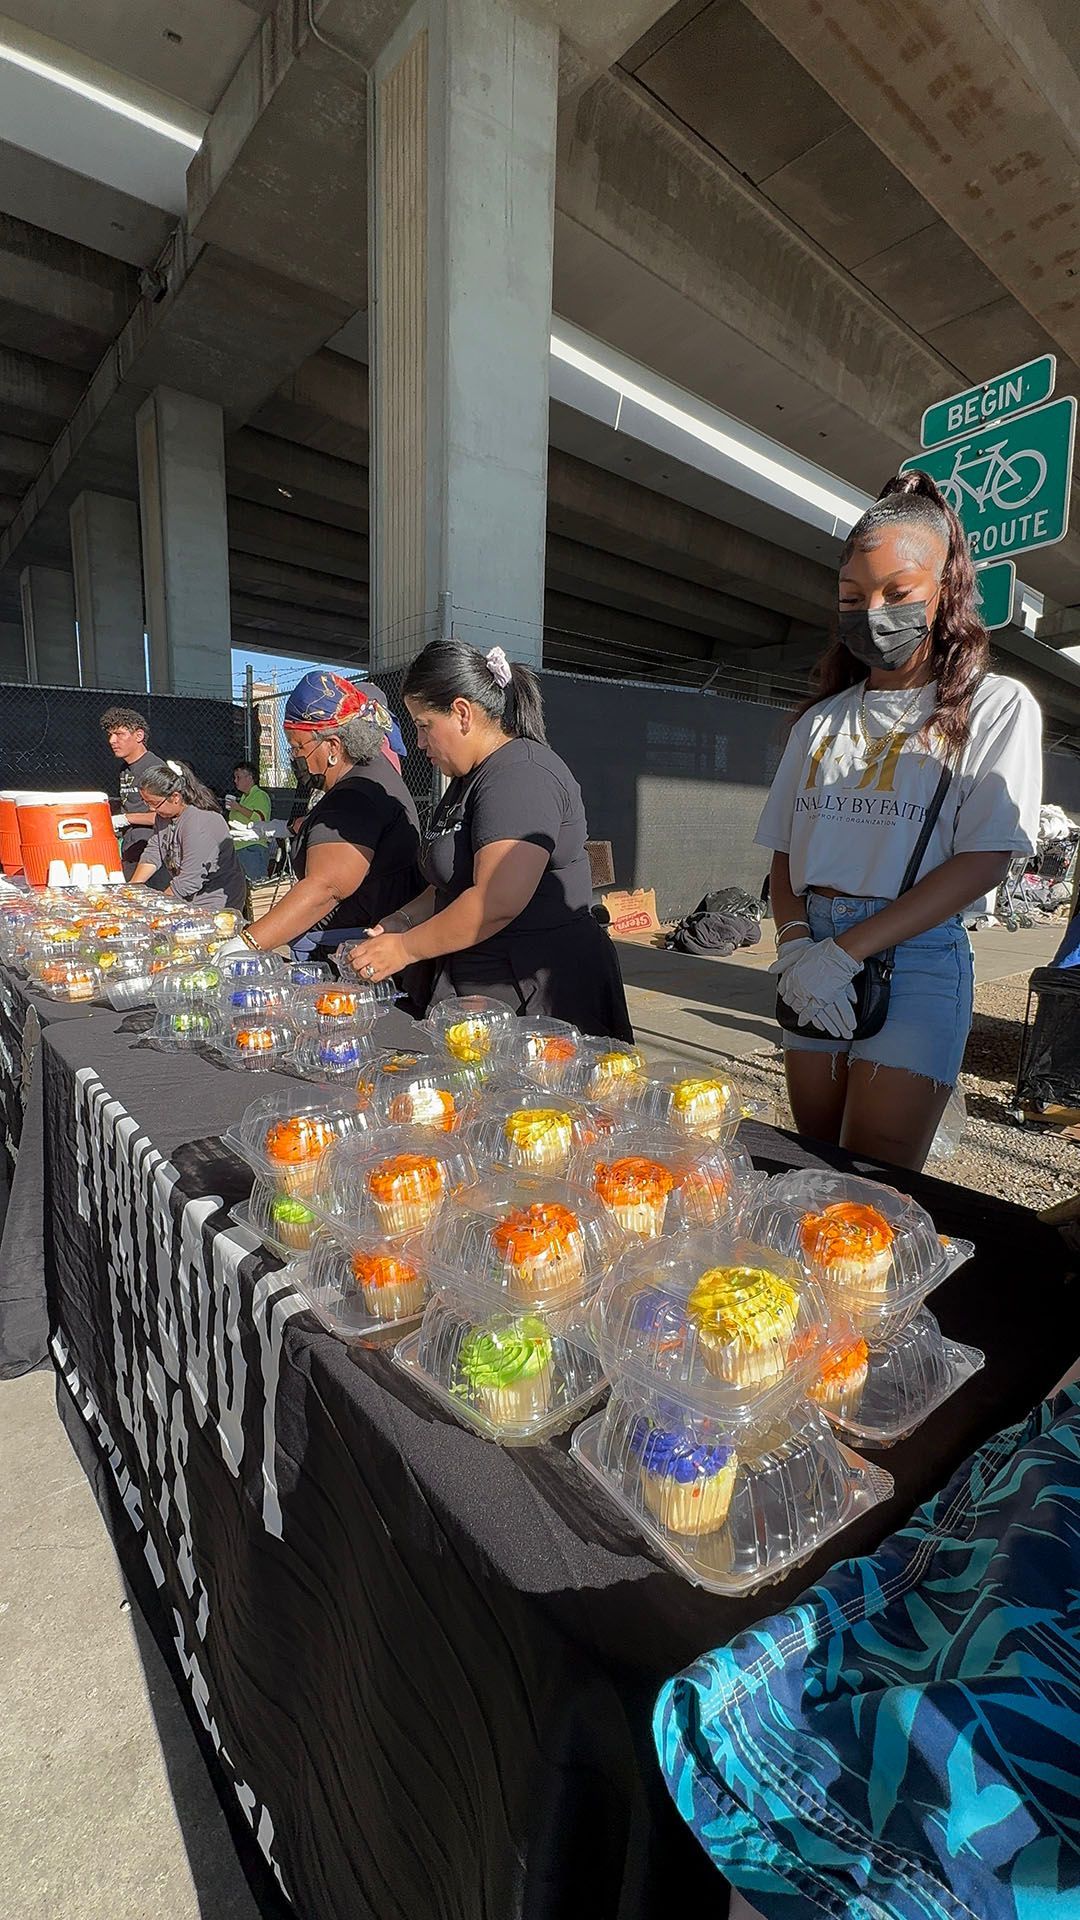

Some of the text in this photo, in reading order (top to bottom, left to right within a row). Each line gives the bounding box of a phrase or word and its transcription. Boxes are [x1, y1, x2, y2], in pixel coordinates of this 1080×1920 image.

[947, 376, 1023, 432] BEGIN
[967, 509, 1049, 554] ROUTE
[795, 795, 848, 812] INALLY
[852, 798, 877, 814] BY
[846, 816, 896, 826] ORGANIZATION
